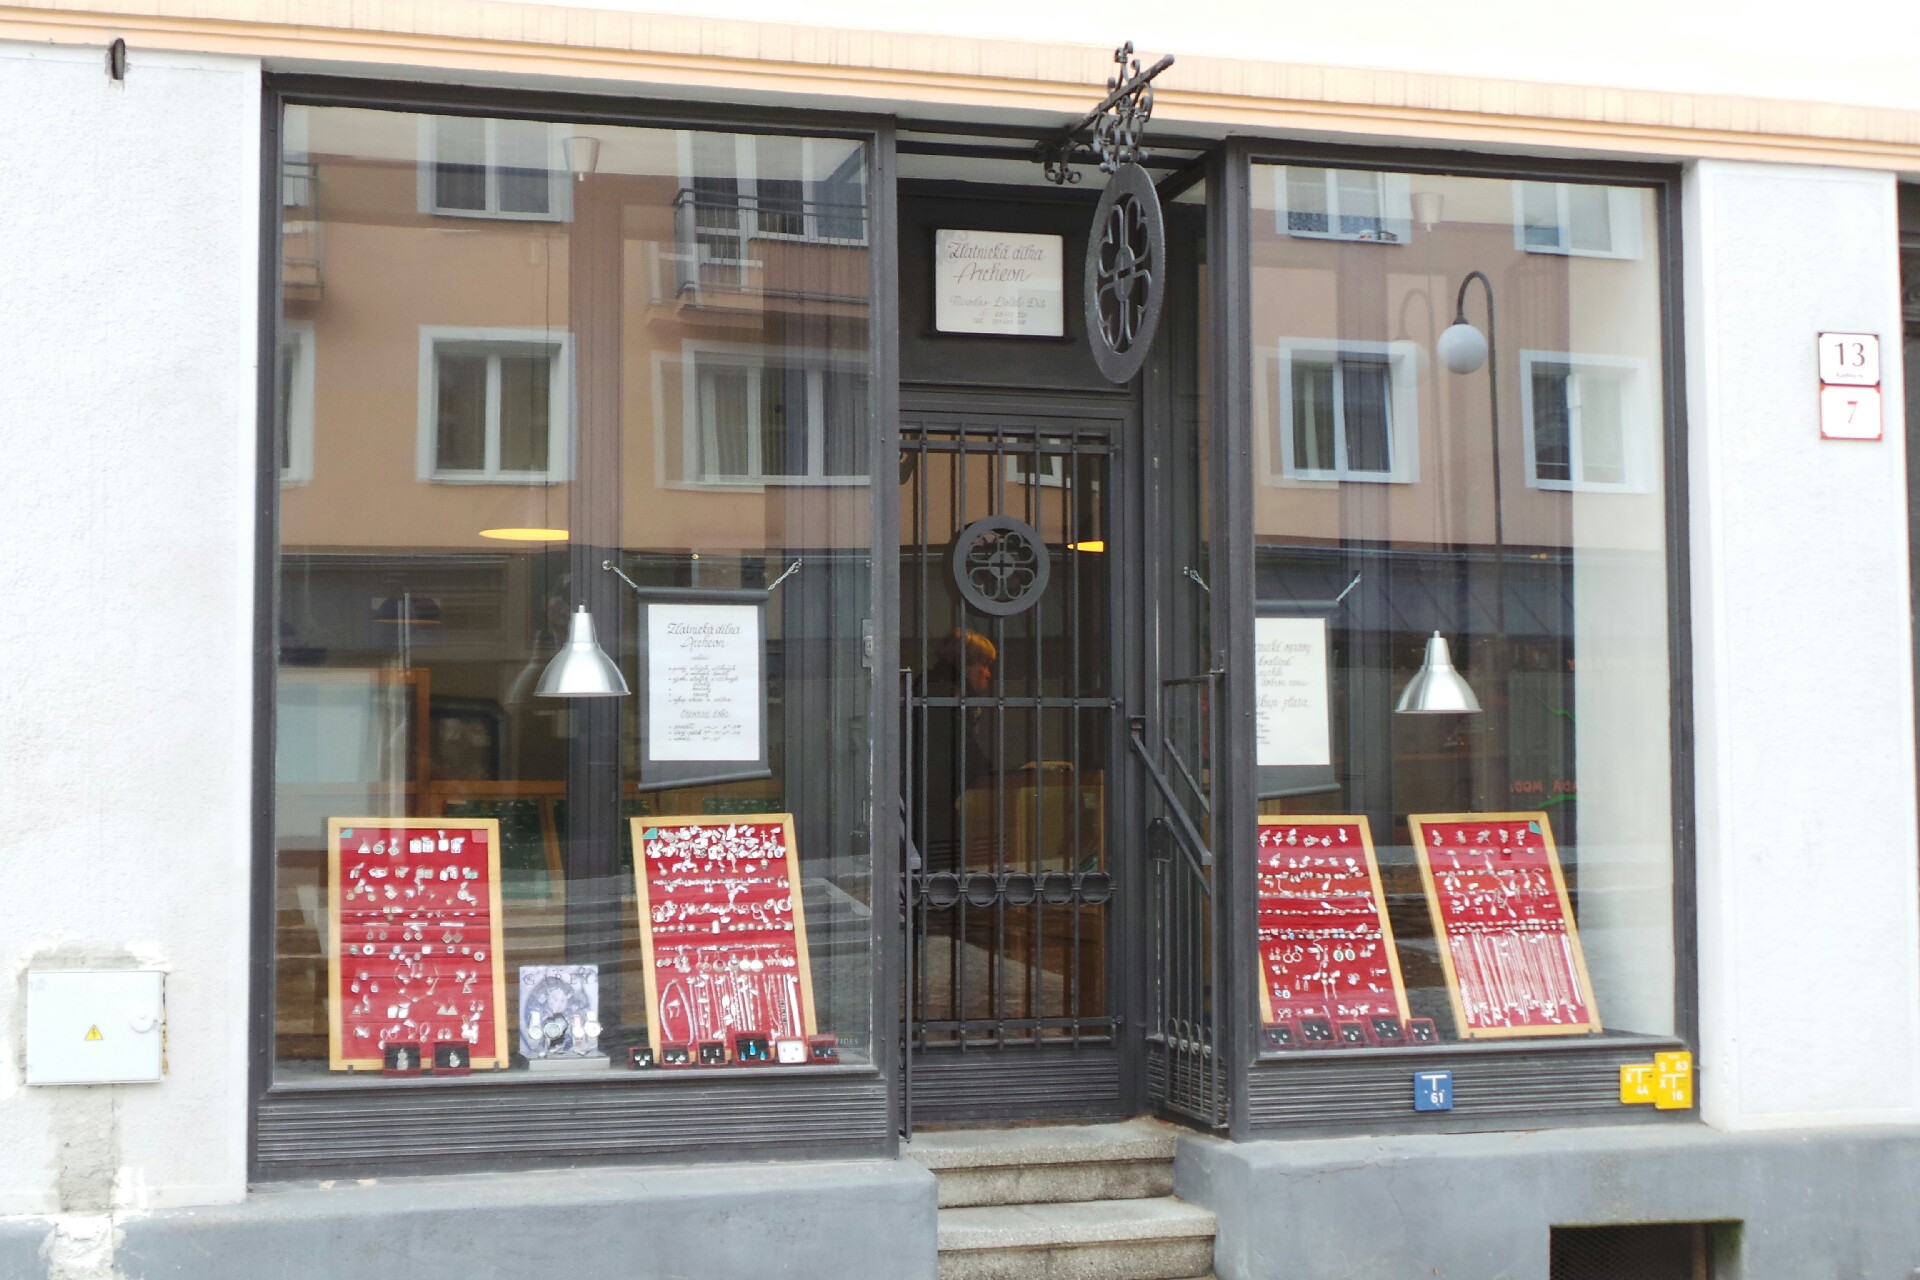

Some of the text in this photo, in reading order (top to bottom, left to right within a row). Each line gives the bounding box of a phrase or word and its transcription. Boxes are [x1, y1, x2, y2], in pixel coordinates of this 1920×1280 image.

[953, 261, 1032, 284] Archeon
[1834, 342, 1866, 367] 13
[1846, 400, 1858, 424] 7
[1430, 1092, 1444, 1104] 61
